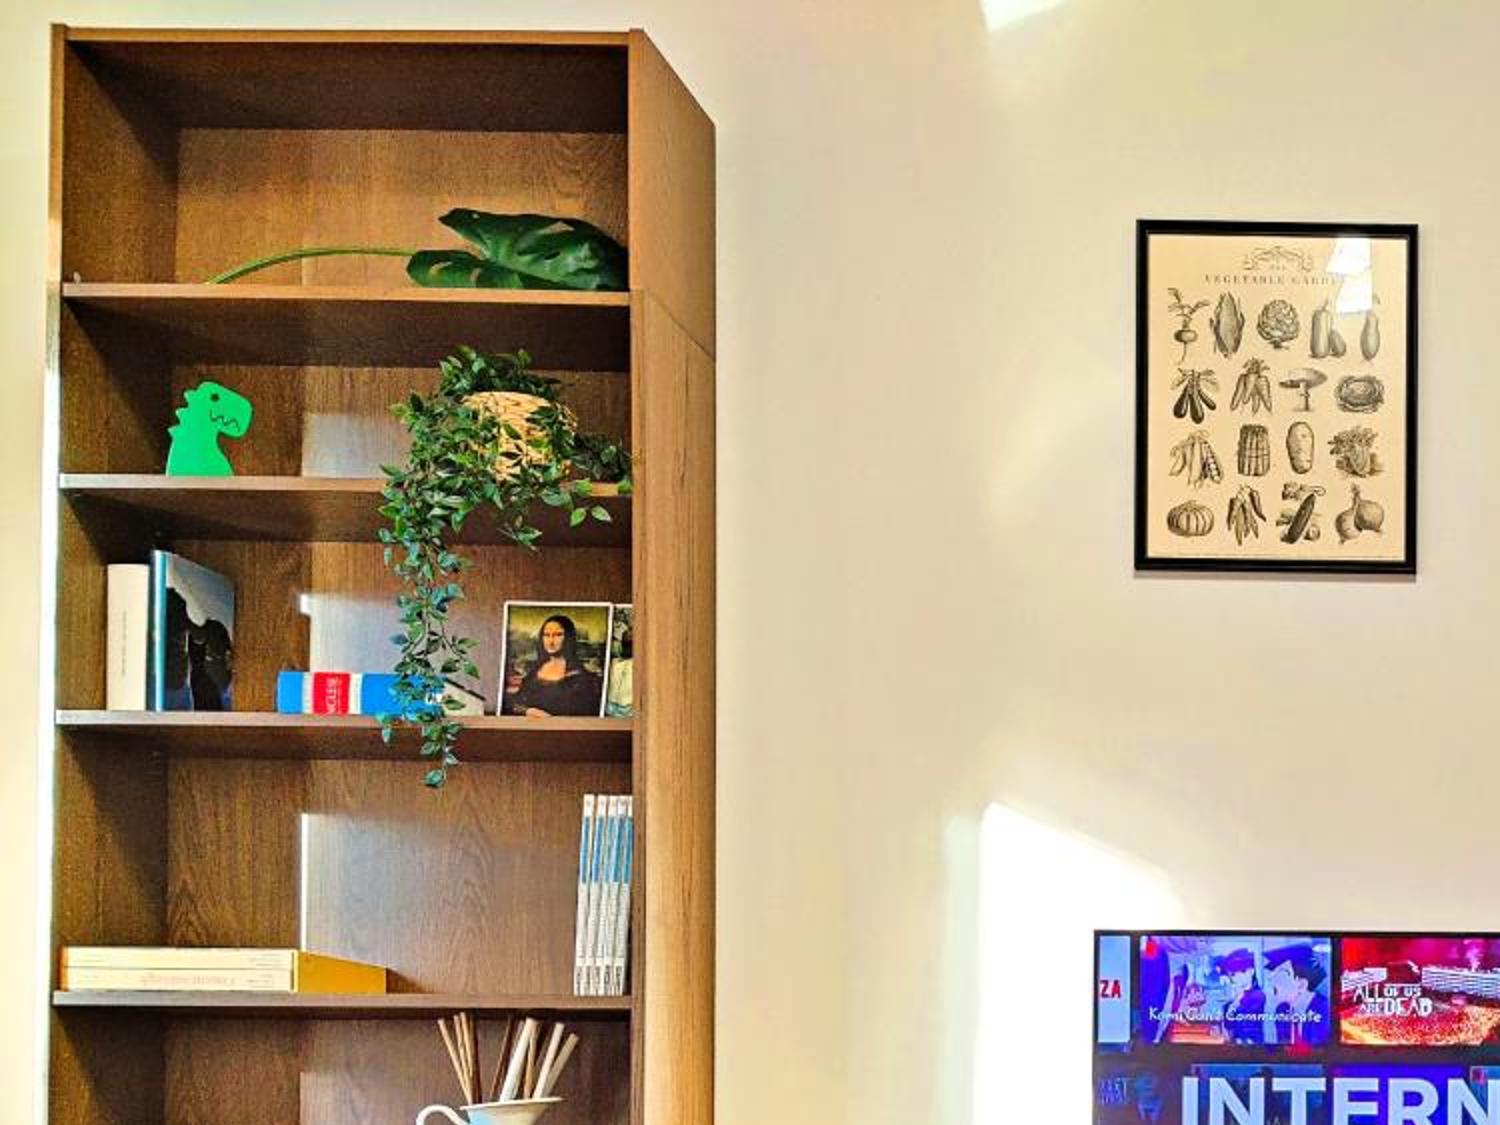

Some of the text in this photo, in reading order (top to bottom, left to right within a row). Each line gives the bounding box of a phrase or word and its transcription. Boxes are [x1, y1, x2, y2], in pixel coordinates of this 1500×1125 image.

[1204, 273, 1285, 286] VEGETABLE
[1225, 1006, 1322, 1024] Communicate
[1384, 997, 1433, 1017] DEAD
